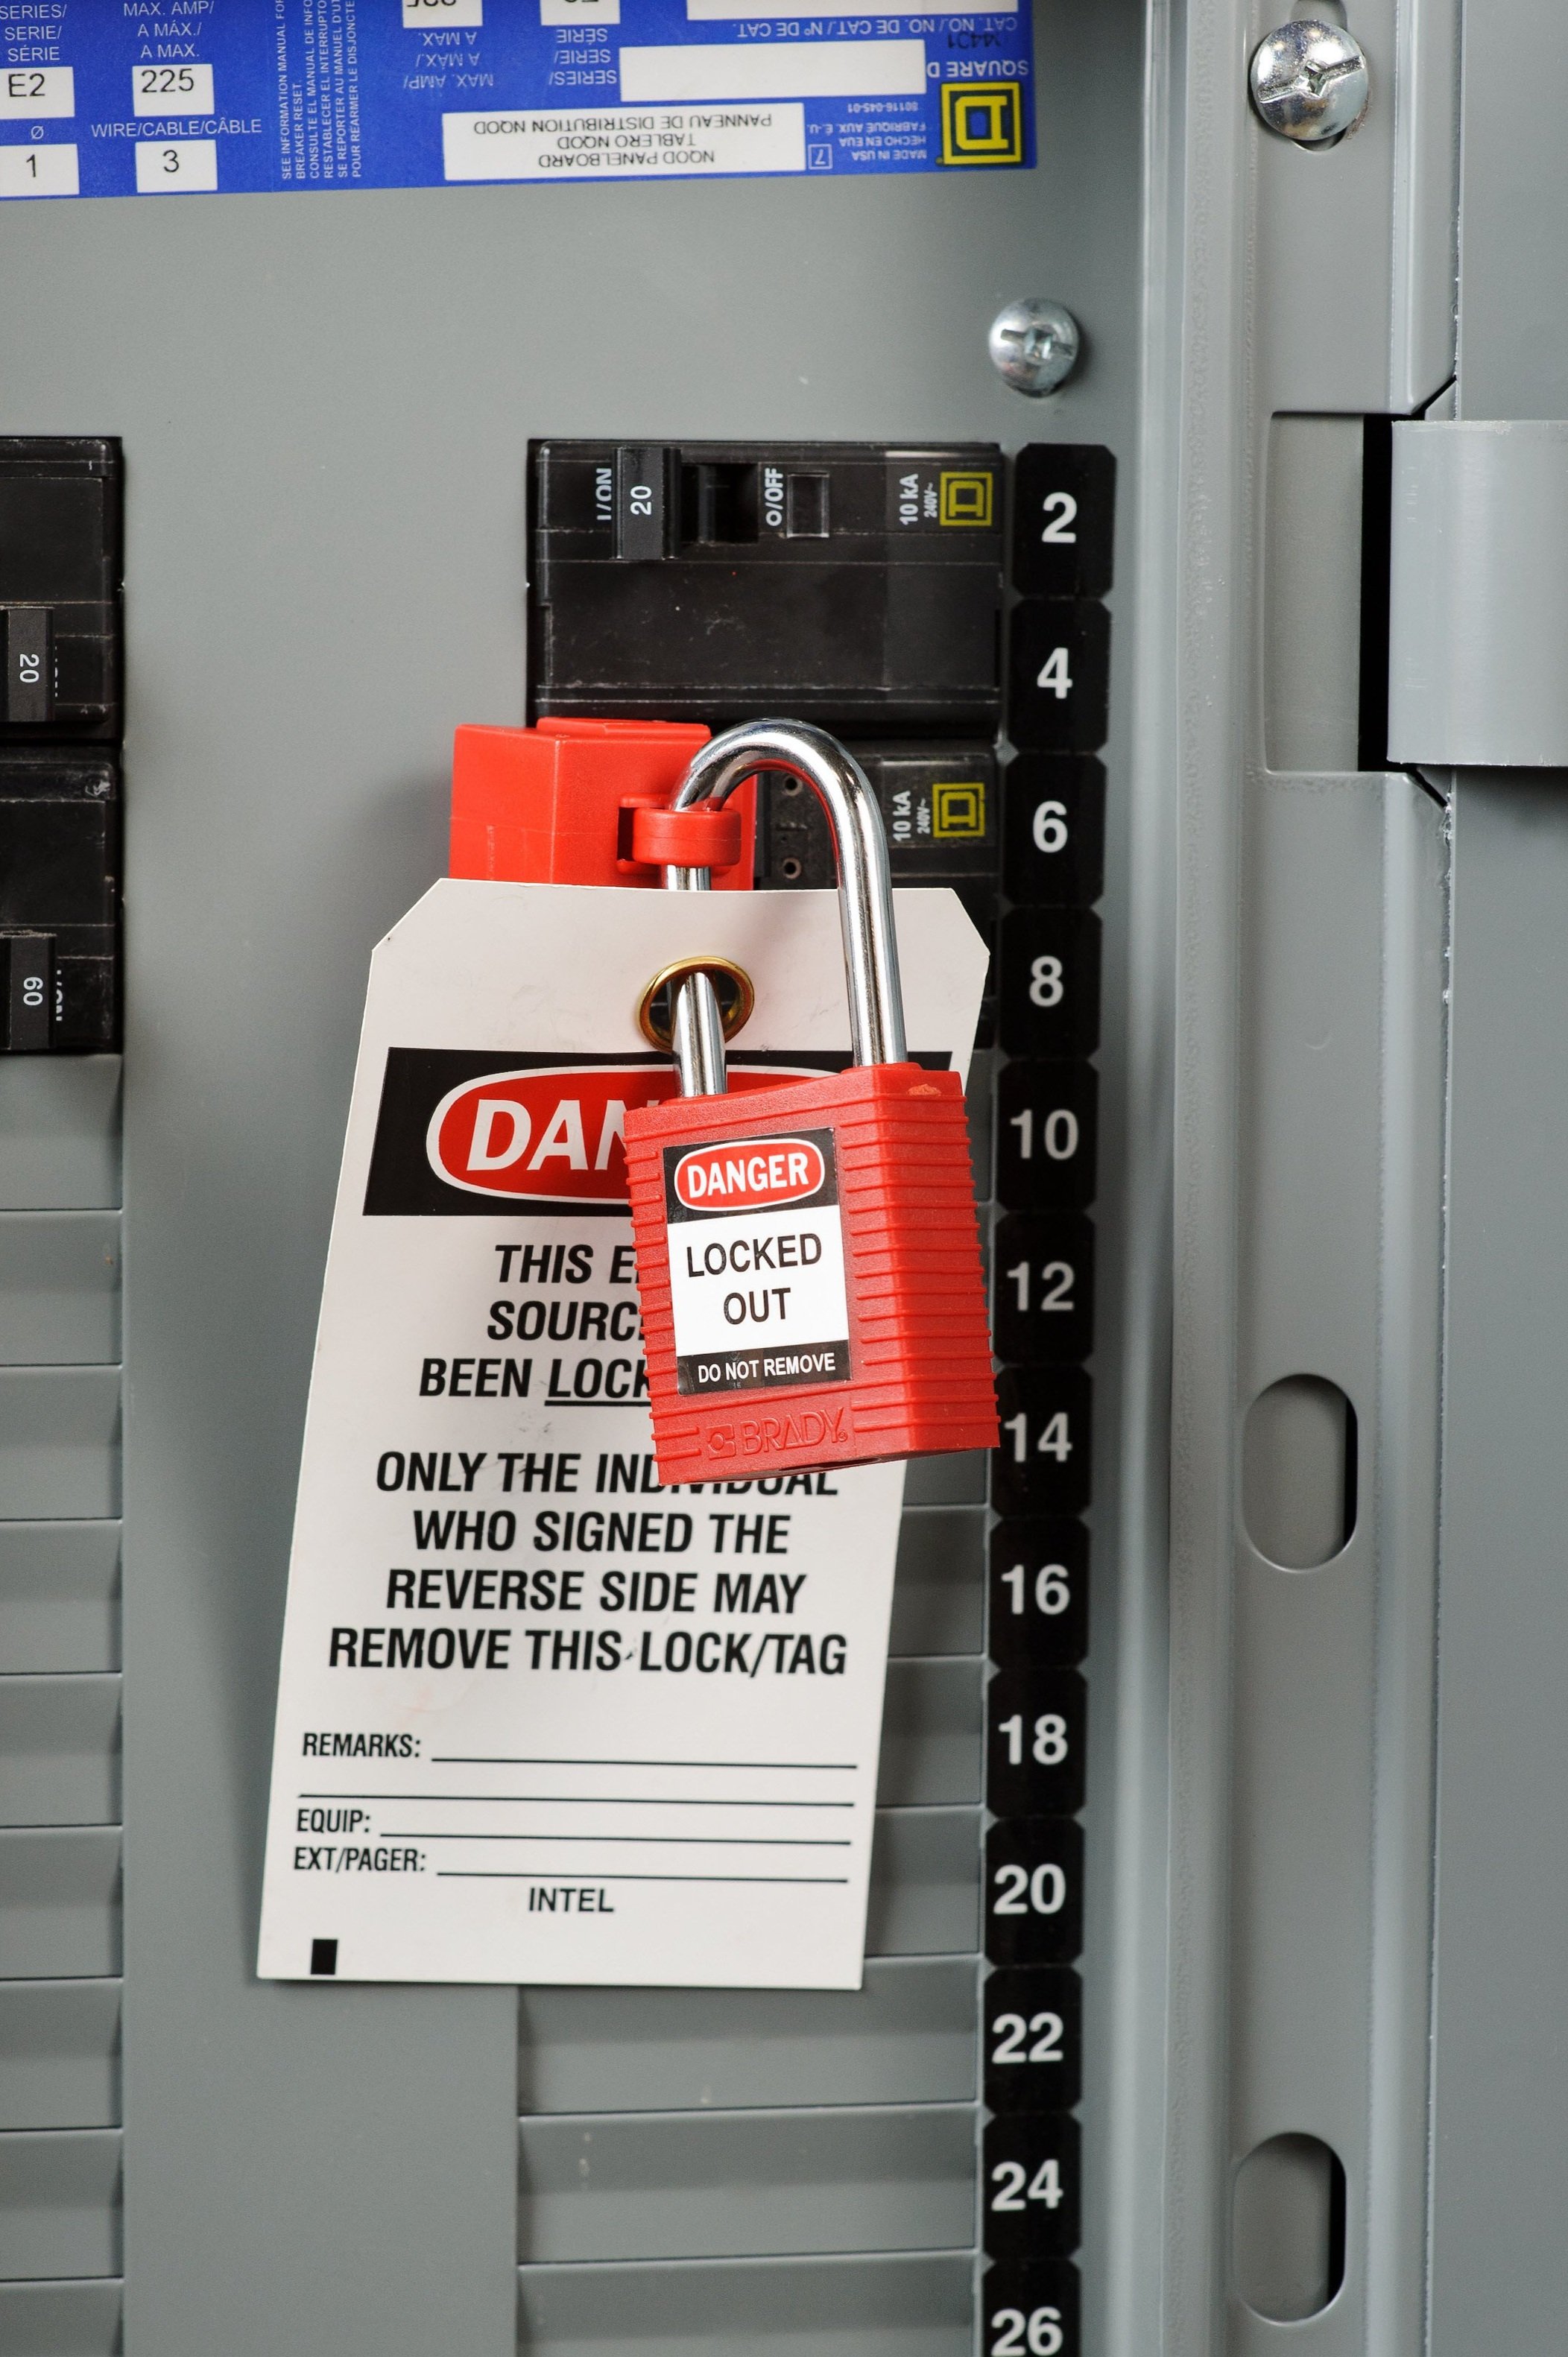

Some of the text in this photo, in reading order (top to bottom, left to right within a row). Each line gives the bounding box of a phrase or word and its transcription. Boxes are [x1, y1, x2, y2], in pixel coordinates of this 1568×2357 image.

[0, 5, 67, 19] SERIES/
[124, 1, 214, 16] MAX. AMP/
[5, 25, 62, 40] SERIE/
[137, 25, 149, 37] A
[305, 29, 314, 44] DE
[346, 1, 357, 65] DISJONCTE
[557, 28, 608, 43] SÉRIE
[733, 23, 771, 37] CAT.
[777, 22, 800, 35] DE
[826, 20, 871, 34] CAT./
[876, 19, 900, 34] DE
[904, 18, 935, 32] NO.
[939, 17, 974, 32] NO./
[978, 17, 1017, 32] CAT.
[8, 45, 60, 61] SÉRIE
[141, 43, 200, 58] A MAX.
[276, 24, 287, 72] MANUAL
[332, 28, 344, 75] MANUEL
[418, 32, 477, 46] A MAX.
[468, 53, 481, 65] A
[553, 49, 611, 64] SERIE/
[927, 61, 1028, 77] SQUARE D
[8, 74, 45, 97] E2
[142, 69, 194, 92] 225
[306, 48, 316, 96] MANUAL
[320, 77, 330, 91] EL
[335, 77, 344, 93] AU
[348, 69, 358, 82] LE
[403, 74, 494, 89] MAX. AMP/
[549, 69, 617, 86] SERIES/
[279, 75, 290, 154] INFORMATION
[307, 100, 317, 114] EL
[92, 118, 262, 137] WIRE/CABLE/CÂBLE
[321, 95, 333, 179] RESTABLECER
[335, 98, 347, 160] REPORTER
[473, 113, 771, 135] PANNEAU DE DISTRIBUTION NQOD
[294, 124, 306, 179] BREAKER
[308, 118, 319, 178] CONSULTE
[557, 133, 697, 150] TABLERO NQOD
[838, 136, 926, 147] HECHO EN EUA
[851, 150, 927, 161] MADE IN USA
[26, 154, 37, 177] 1
[162, 150, 180, 172] 3
[282, 158, 291, 179] SEE
[338, 164, 347, 177] SE
[351, 145, 361, 177] POUR
[538, 150, 714, 168] NQOD PANELBOARD
[630, 485, 652, 516] 20
[765, 468, 784, 527] O/OFF
[900, 473, 918, 525] 10 kA
[1042, 493, 1077, 543] 2
[19, 654, 40, 684] 20
[1037, 647, 1072, 699] 4
[893, 790, 911, 842] 10 kA
[1033, 801, 1068, 852] 6
[23, 976, 43, 1007] 60
[1028, 955, 1064, 1007] 8
[1010, 1108, 1079, 1160] 10
[686, 1152, 809, 1199] DANGER
[495, 1244, 594, 1283] THIS
[686, 1233, 822, 1277] LOCKED
[1007, 1261, 1074, 1312] 12
[724, 1288, 791, 1324] OUT
[487, 1301, 643, 1341] SOURC
[420, 1358, 532, 1397] BEEN
[698, 1352, 835, 1383] DO NOT REMOVE
[740, 1408, 844, 1455] BRADY
[1004, 1412, 1072, 1463] 14
[376, 1451, 487, 1492] ONLY
[496, 1452, 582, 1492] THE
[414, 1510, 791, 1553] WHO SIGNED THE
[386, 1569, 806, 1613] REVERSE SIDE MAY
[1001, 1563, 1070, 1616] 16
[329, 1627, 847, 1678] REMOVE THIS LOCK/TAG
[303, 1733, 421, 1758] REMARKS:
[999, 1714, 1068, 1765] 18
[297, 1809, 371, 1833] EQUIP:
[294, 1847, 426, 1873] EXT/PAGER:
[529, 1888, 614, 1913] INTEL
[993, 1864, 1066, 1914] 20
[991, 2013, 1064, 2064] 22
[991, 2160, 1063, 2212] 24
[990, 2306, 1063, 2356] 26
